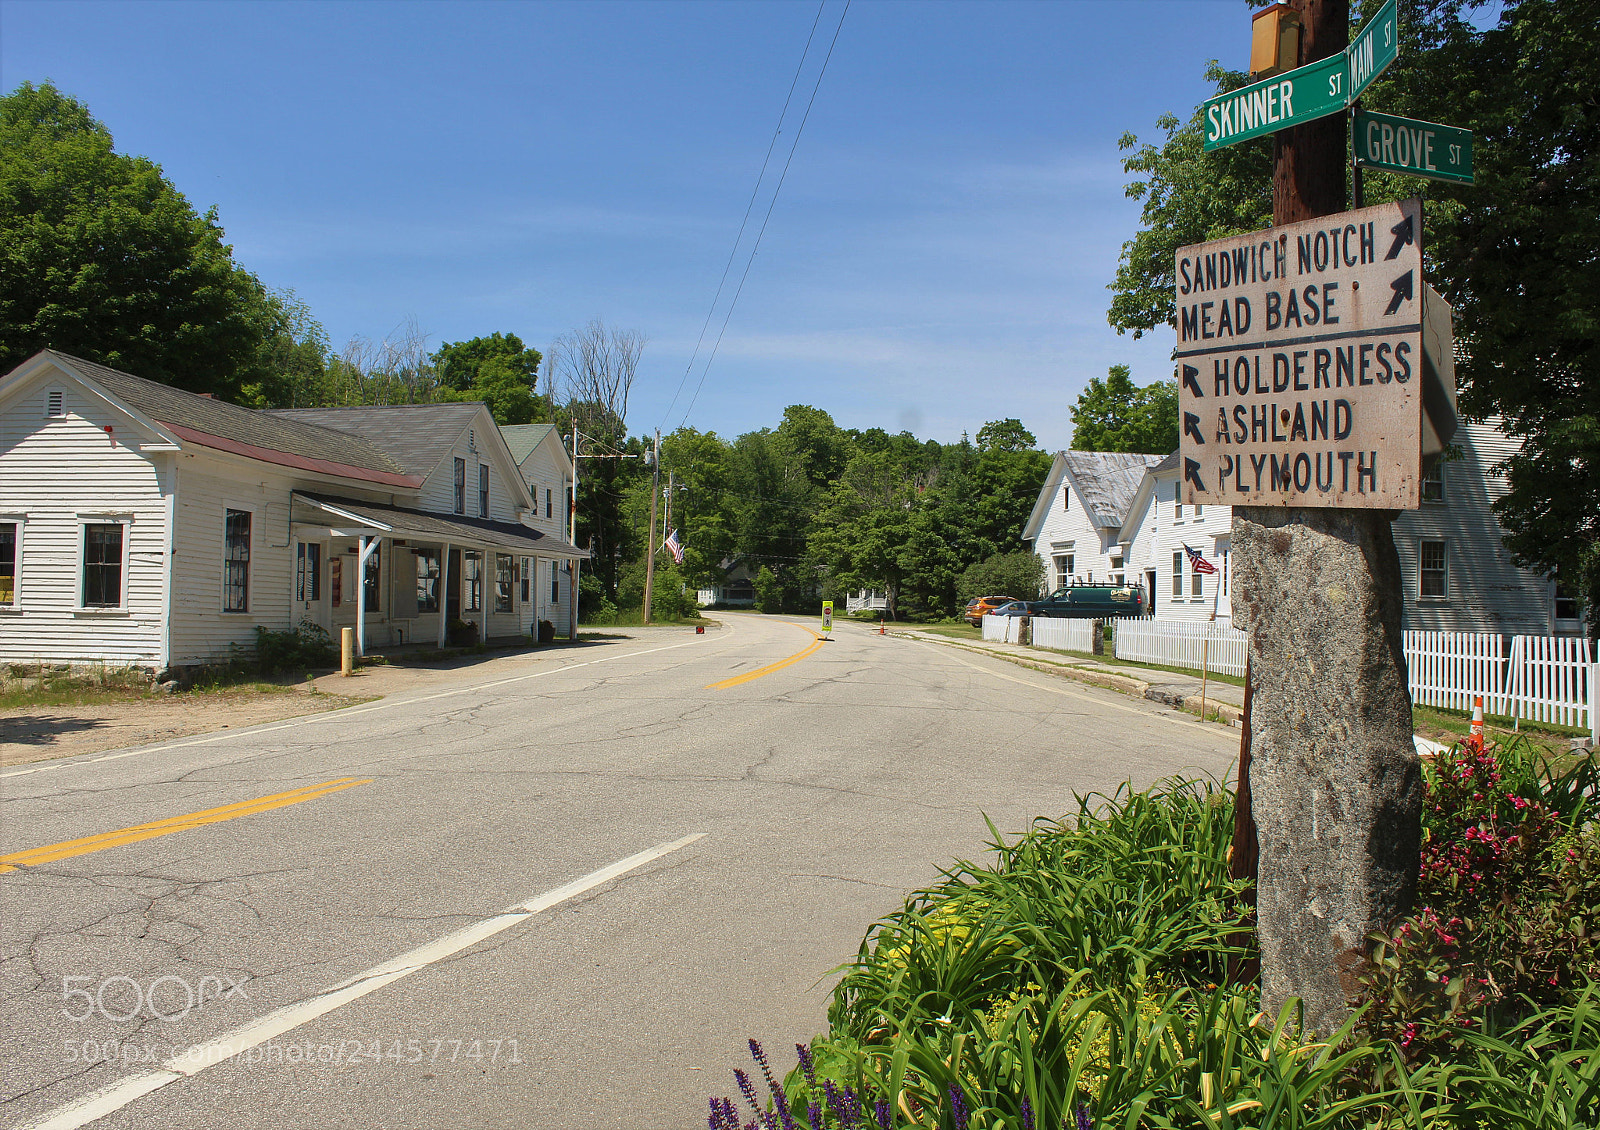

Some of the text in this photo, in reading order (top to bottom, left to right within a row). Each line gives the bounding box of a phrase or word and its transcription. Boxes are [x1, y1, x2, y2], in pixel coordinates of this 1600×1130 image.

[1351, 20, 1392, 94] MAIN ST
[1208, 72, 1342, 142] SKINNER ST
[1366, 120, 1461, 171] GROVE ST
[1180, 221, 1374, 295] SANDWICH NOTCH
[1182, 282, 1340, 342] MEAD BASE
[1214, 342, 1411, 397] HOLDERNESS
[1215, 399, 1352, 445] ASHLAND
[1219, 451, 1377, 494] PLYMOUTH
